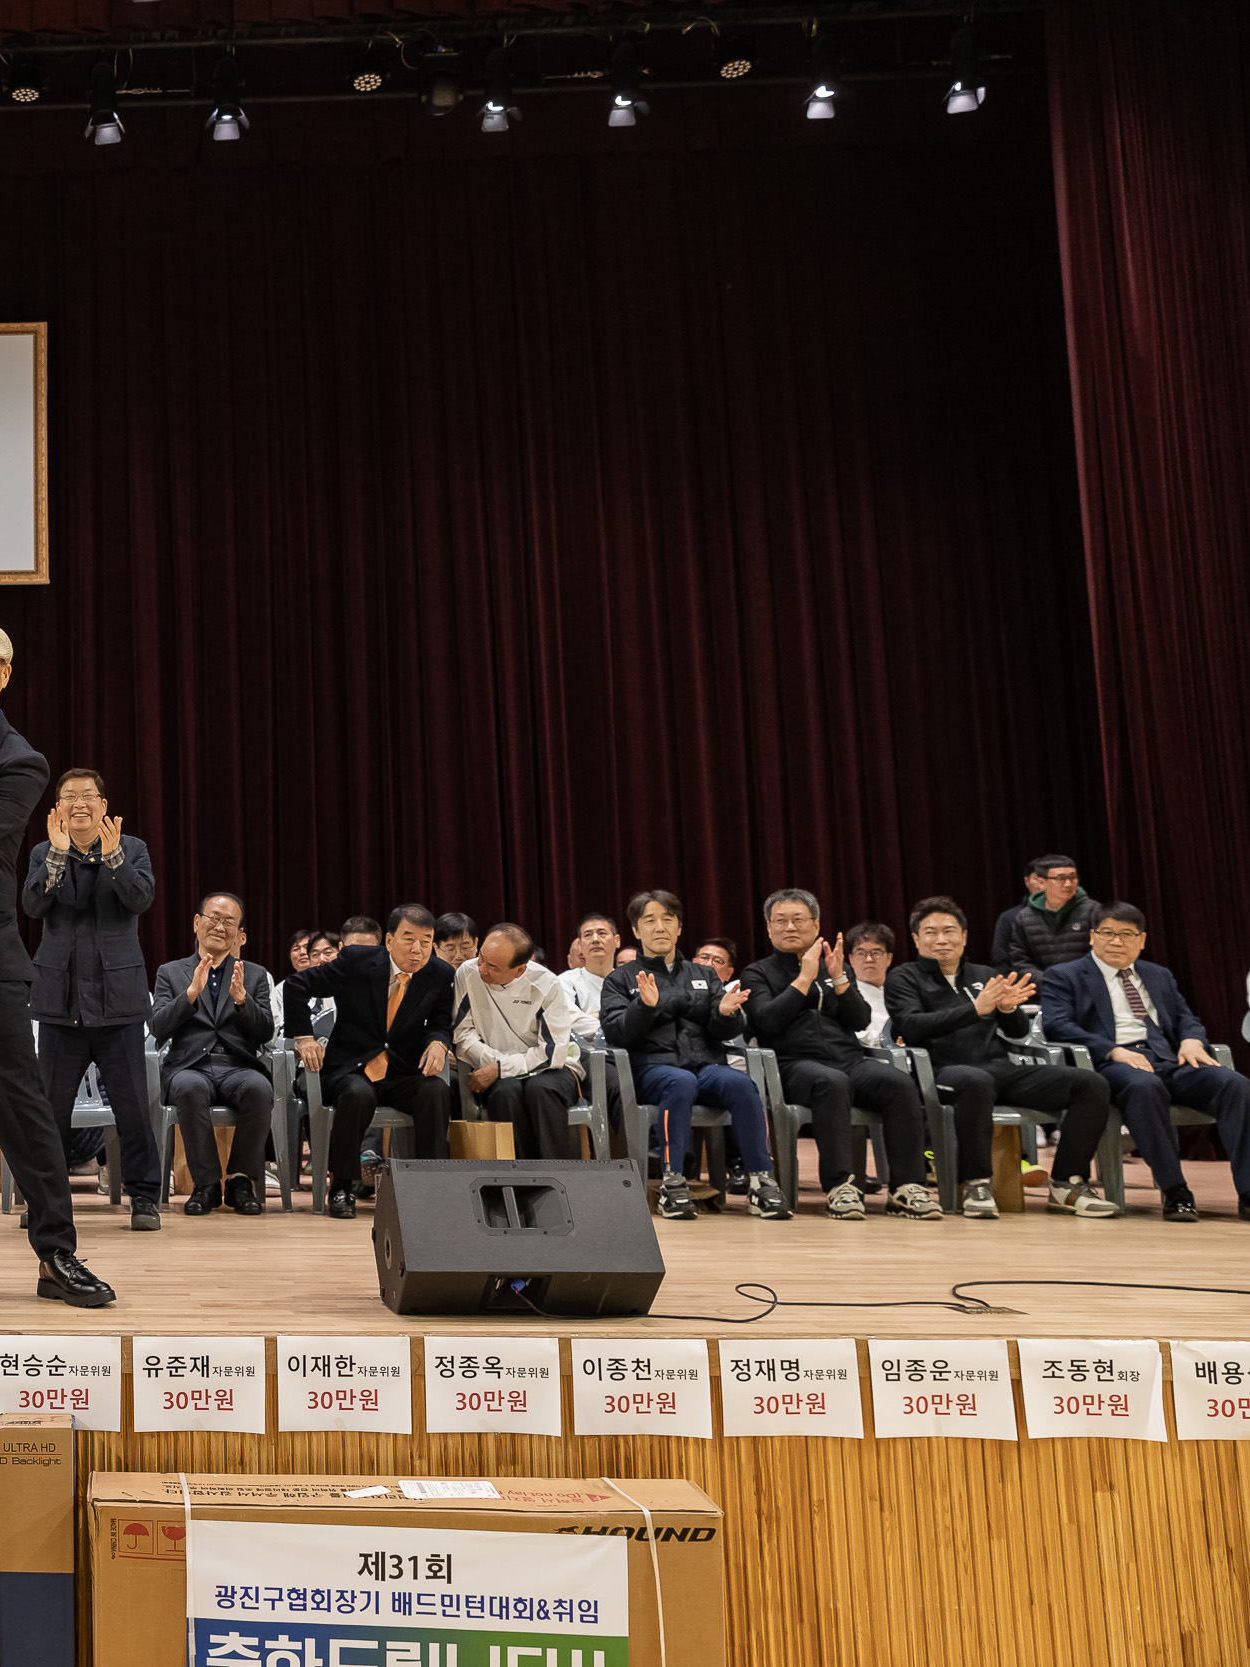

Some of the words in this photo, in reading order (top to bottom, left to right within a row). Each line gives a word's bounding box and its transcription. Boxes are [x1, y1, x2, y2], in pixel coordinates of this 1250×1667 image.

[0, 1354, 67, 1376] 현승순
[69, 1366, 110, 1376] 자문위원
[143, 1356, 209, 1378] 유준재
[213, 1366, 254, 1377] 자문위원
[288, 1355, 356, 1377] 이재한
[358, 1366, 399, 1377] 자문위원
[435, 1356, 503, 1379] 정종옥
[506, 1367, 548, 1378] 자문위원
[583, 1358, 651, 1381] 이종천
[655, 1370, 697, 1380] 자문위원
[731, 1359, 799, 1381] 정재명
[804, 1369, 846, 1380] 자문위원
[882, 1360, 951, 1381] 임종운
[954, 1371, 998, 1381] 자문위원
[1043, 1359, 1114, 1382] 조동현
[1118, 1371, 1140, 1381] 회장
[20, 1389, 89, 1410] 30만원
[163, 1389, 233, 1411] 30만원
[308, 1389, 378, 1411] 30만원
[456, 1390, 526, 1412] 30만원
[605, 1392, 676, 1414] 30만원
[754, 1392, 826, 1415] 30만원
[903, 1393, 977, 1416] 30만원
[1054, 1394, 1129, 1417] 30만원
[3, 1443, 39, 1452] ULTRA
[41, 1443, 56, 1452] HD
[12, 1457, 62, 1467] Backlight
[358, 1552, 451, 1584] 제31회
[216, 1586, 379, 1614] 광진구협회장기
[392, 1592, 598, 1623] 배드민턴대회&취임
